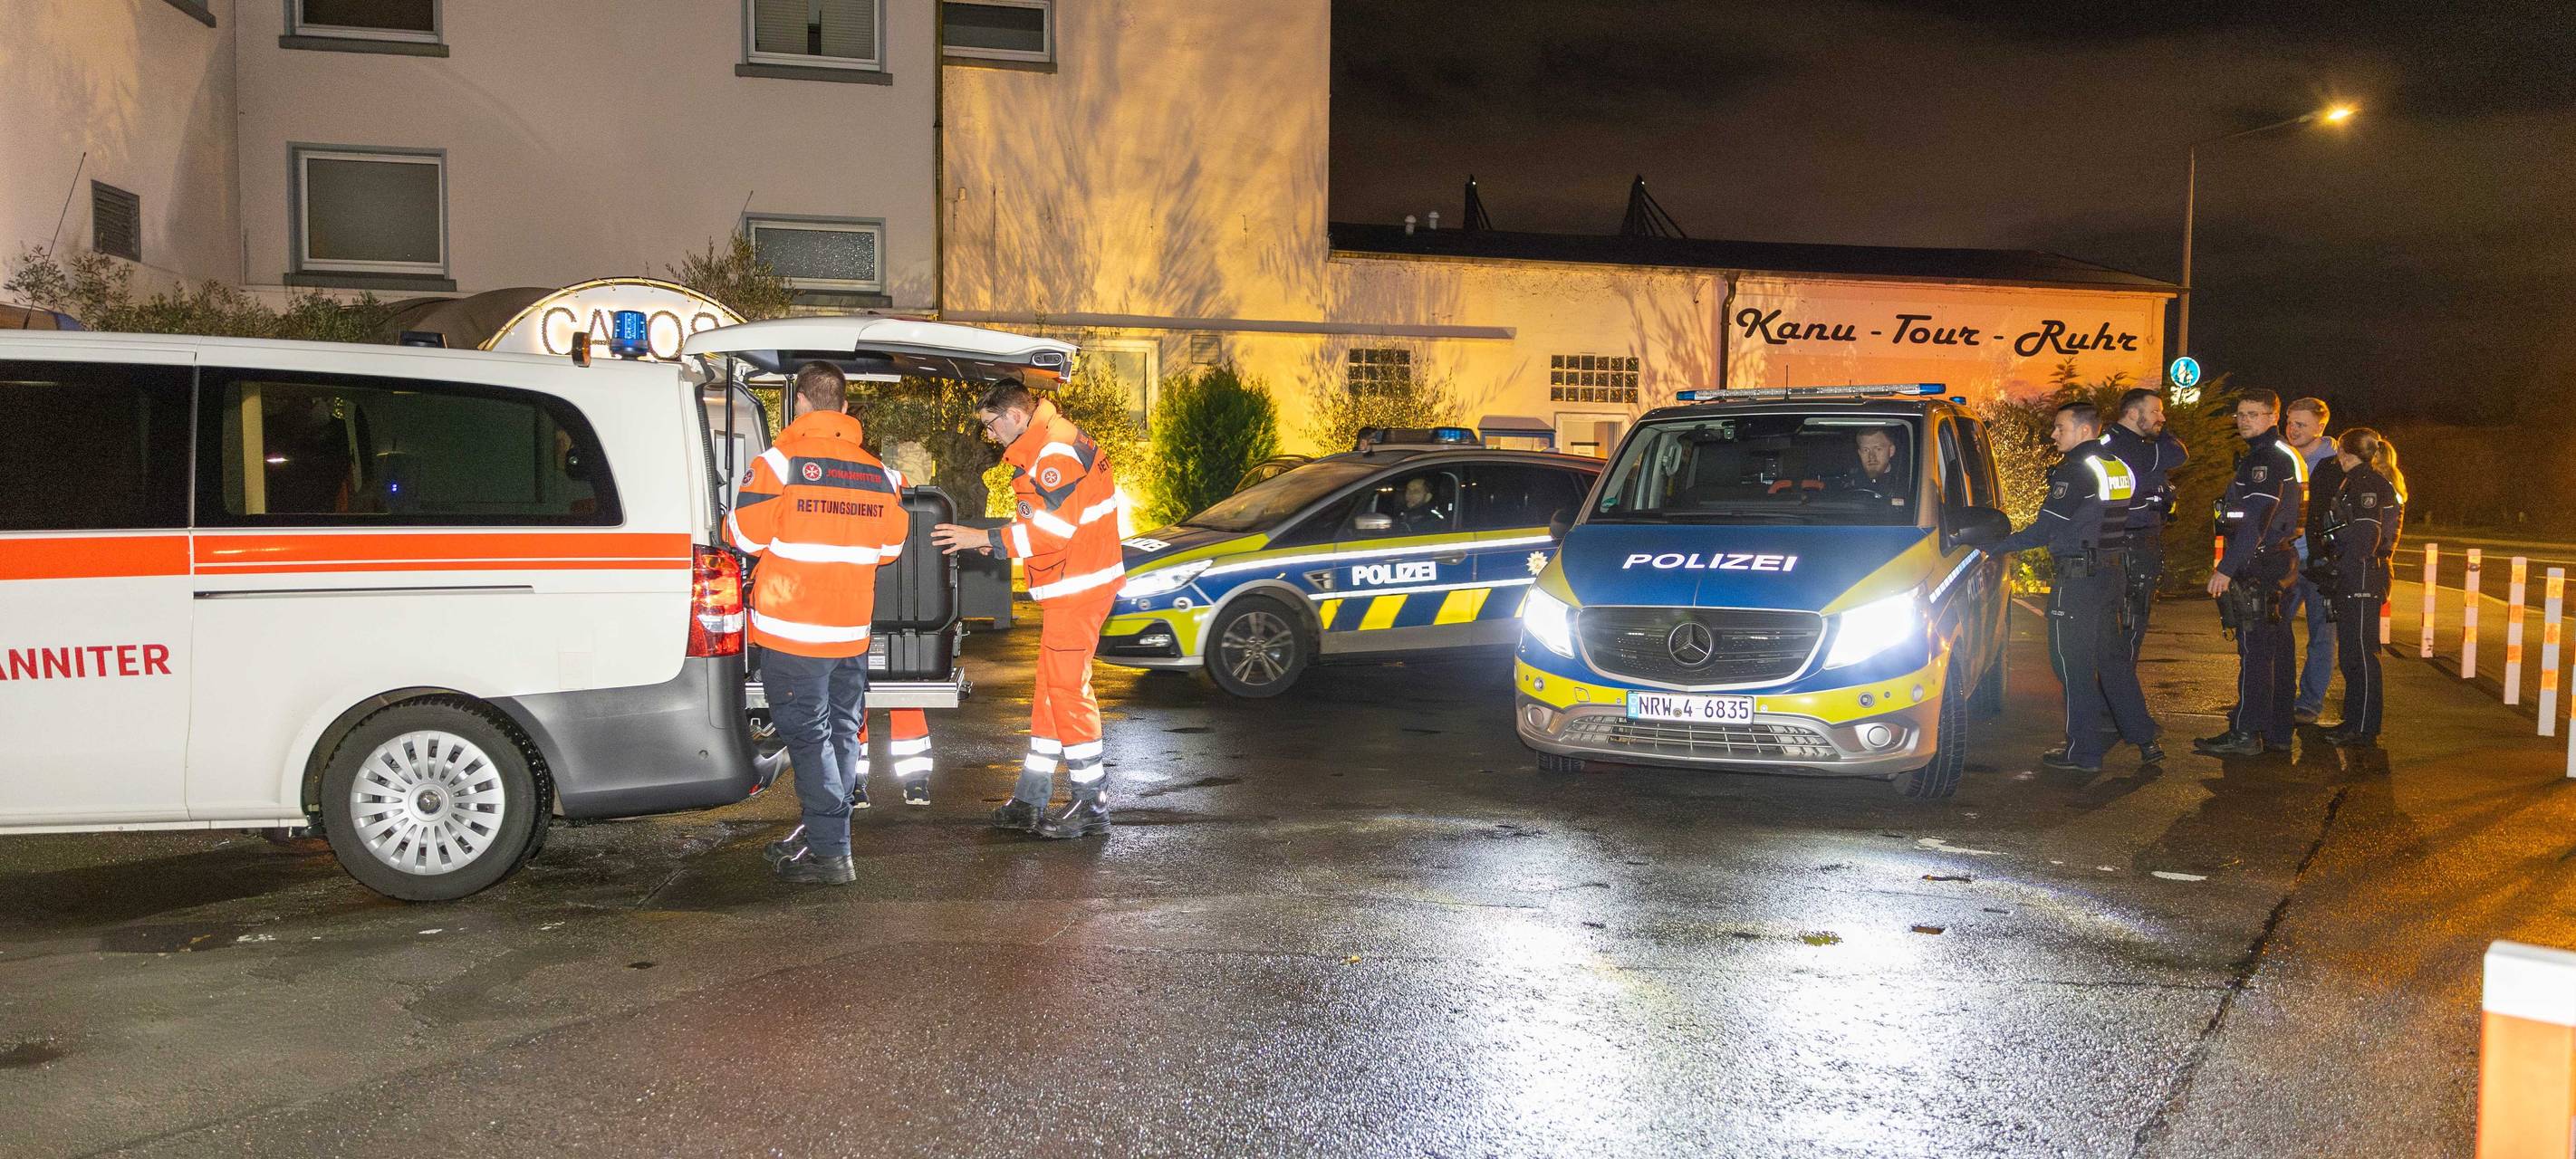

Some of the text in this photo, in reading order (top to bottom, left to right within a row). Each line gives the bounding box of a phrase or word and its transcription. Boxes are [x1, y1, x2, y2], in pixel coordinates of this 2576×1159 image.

[542, 307, 721, 360] CAO
[1735, 308, 1857, 345] Kanu
[1891, 314, 1980, 345] Tour
[2014, 320, 2138, 357] Ruhr
[797, 499, 884, 518] RETTUNGSDIENST
[1351, 561, 1437, 586] POLIZEI
[1622, 553, 1798, 572] POLIZEI
[0, 644, 172, 681] NNITER
[1639, 695, 1672, 716] NRW
